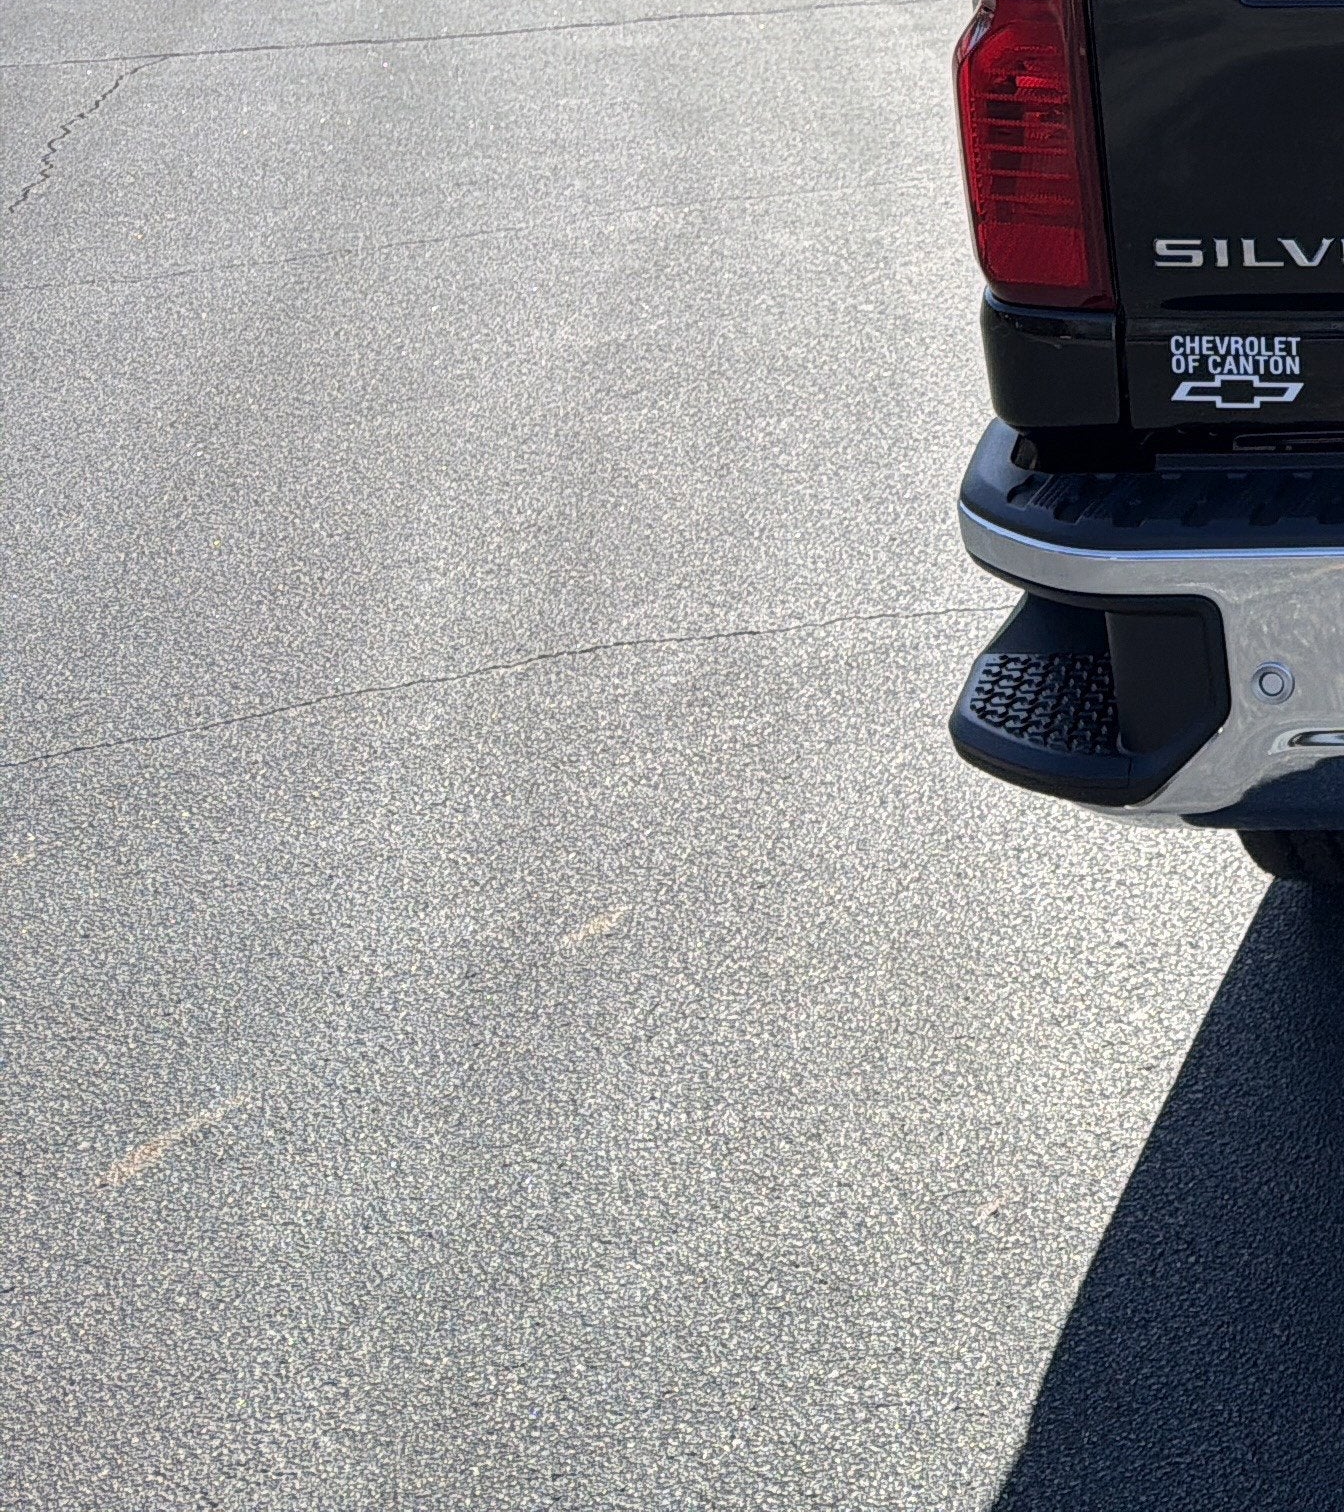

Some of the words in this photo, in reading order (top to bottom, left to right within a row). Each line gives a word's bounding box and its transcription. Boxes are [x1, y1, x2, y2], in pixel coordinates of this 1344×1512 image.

[1170, 335, 1301, 356] CHEVROLET
[1171, 355, 1200, 374] OF
[1207, 355, 1300, 375] CANTON
